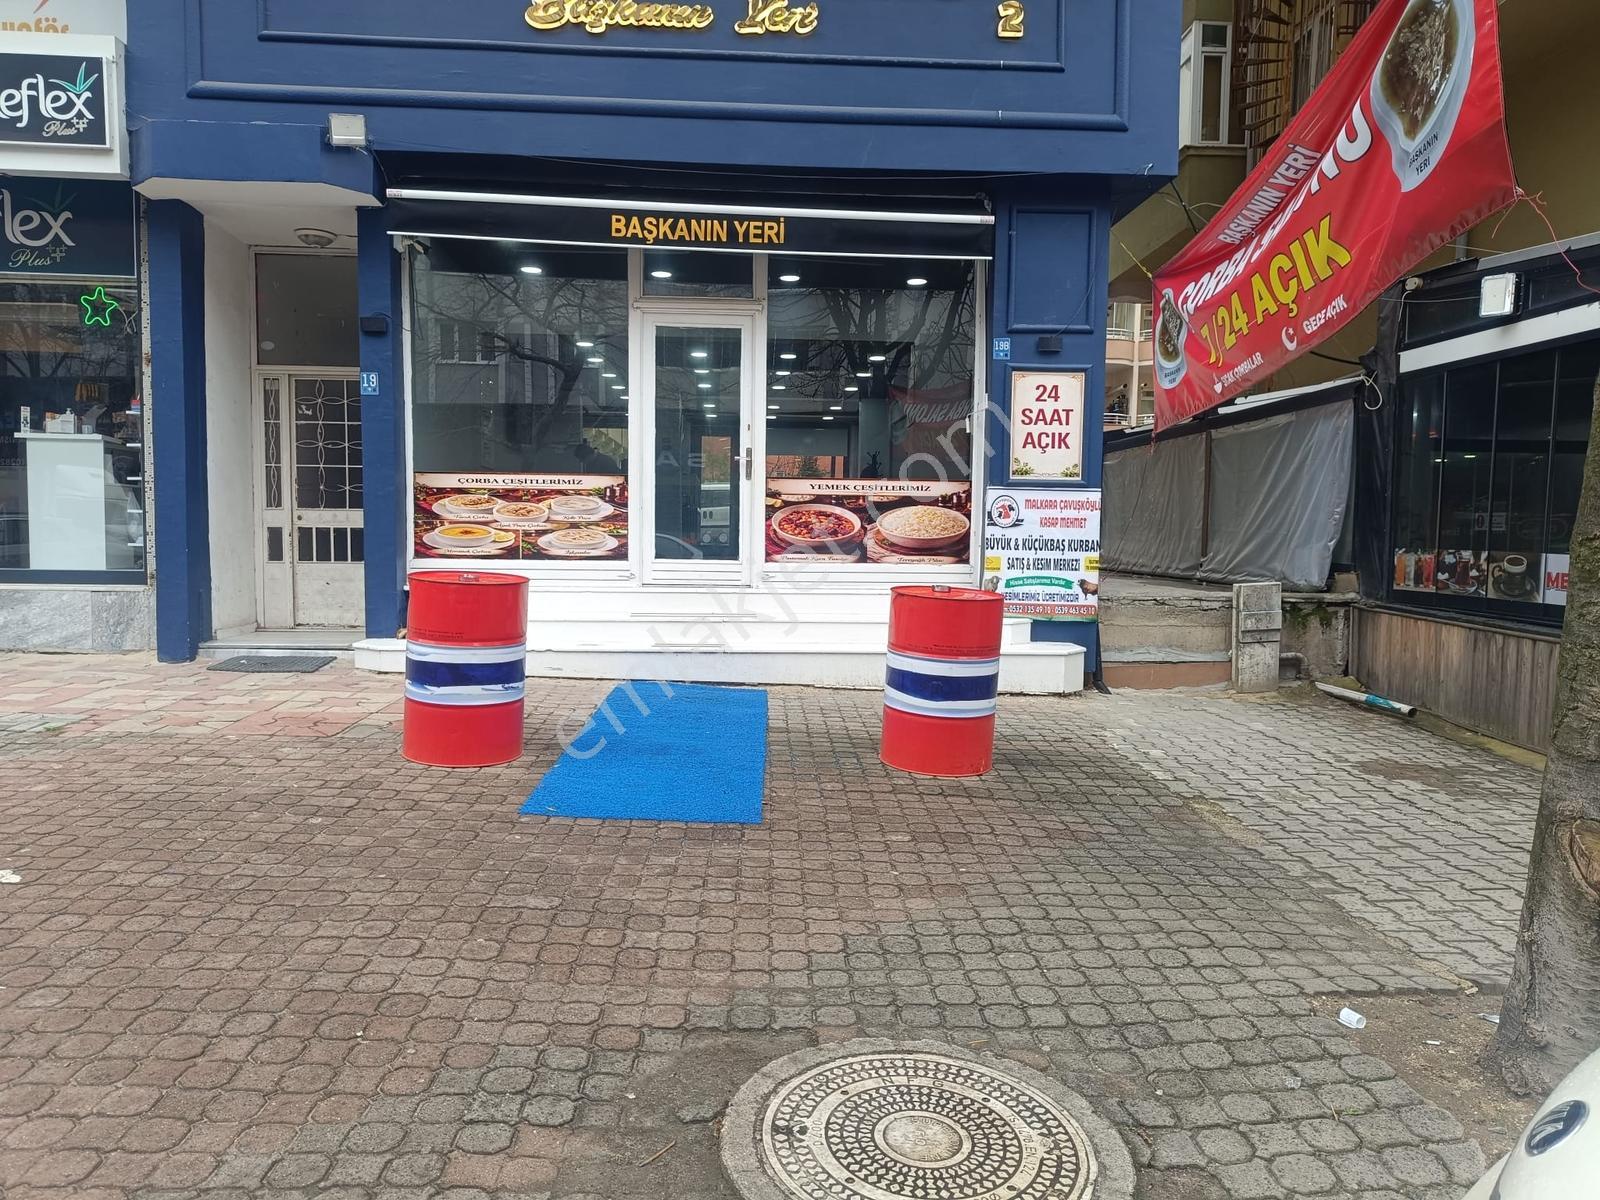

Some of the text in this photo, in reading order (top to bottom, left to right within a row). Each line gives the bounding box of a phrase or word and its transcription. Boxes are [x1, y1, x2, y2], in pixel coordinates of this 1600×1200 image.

[997, 0, 1024, 37] 2
[0, 73, 95, 128] eflex
[42, 120, 77, 137] Plus
[1267, 142, 1322, 188] YERİ
[0, 188, 76, 247] lex
[611, 214, 785, 244] BAŞKANIN YERİ
[8, 248, 51, 268] Plus
[1250, 212, 1353, 325] AÇIK
[362, 373, 377, 387] 19
[1035, 384, 1061, 403] 24
[1021, 407, 1074, 427] SAAT
[1022, 431, 1071, 454] AÇIK
[457, 476, 583, 487] ÇORBA ÇEŞİTLERİMİZ
[809, 483, 851, 491] YEMEK
[1024, 499, 1058, 510] MALKARA
[1040, 517, 1087, 529] KASAP MEHMET
[986, 534, 1101, 556] BÜYÜK & KÜÇÜKBAŞ KURBAN
[1007, 557, 1025, 573] SATIŞ
[1026, 558, 1031, 571] &
